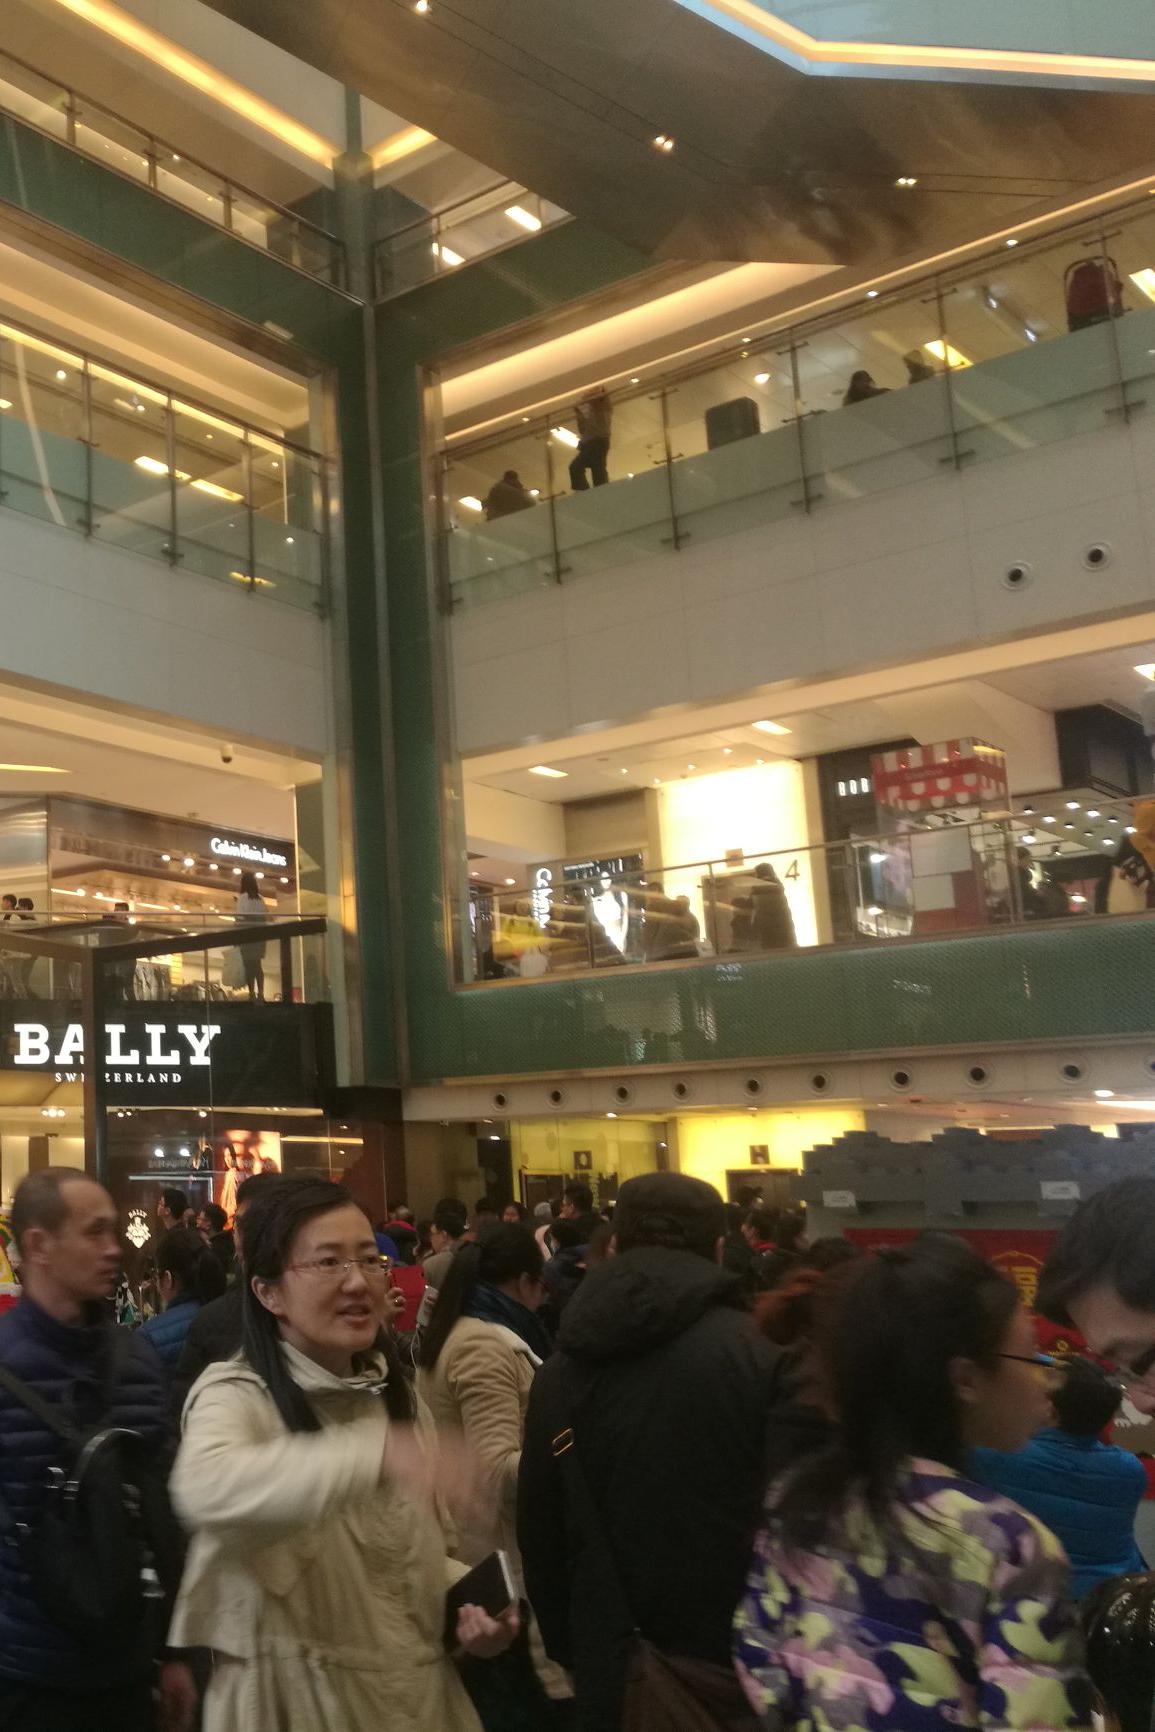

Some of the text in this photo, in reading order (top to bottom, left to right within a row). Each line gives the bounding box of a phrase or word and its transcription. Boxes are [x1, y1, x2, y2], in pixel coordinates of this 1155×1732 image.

[784, 860, 800, 881] 4
[13, 1023, 222, 1065] BALLY
[54, 1072, 182, 1083] SWIZERLAND
